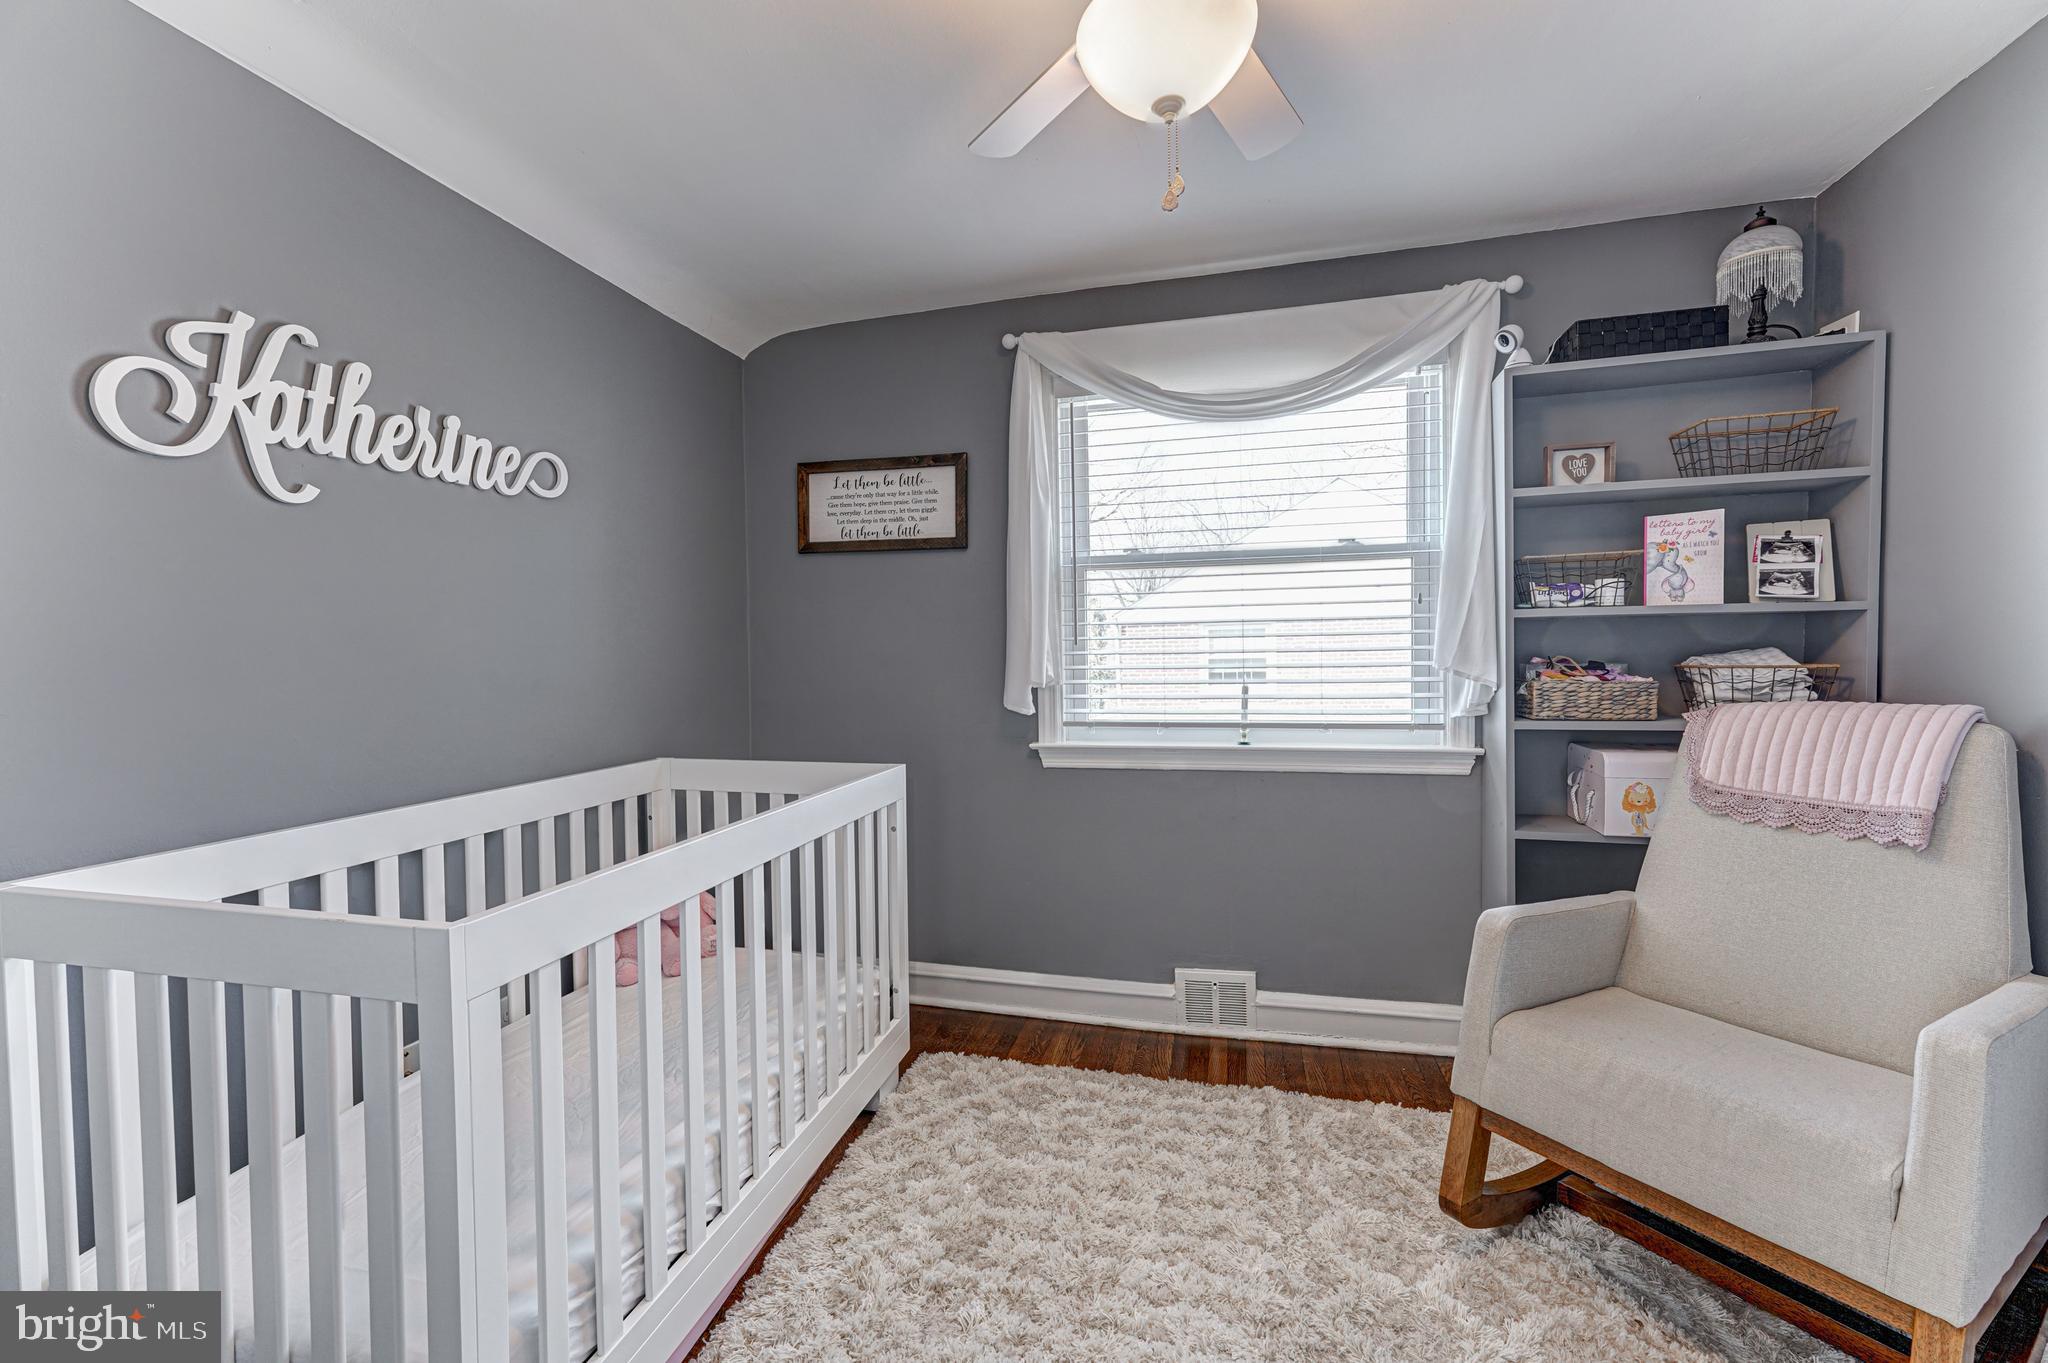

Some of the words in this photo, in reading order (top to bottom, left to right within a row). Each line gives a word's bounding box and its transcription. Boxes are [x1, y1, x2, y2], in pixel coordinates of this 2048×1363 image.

[89, 310, 569, 504] Katherine
[1568, 458, 1588, 469] LOVE
[1572, 467, 1587, 477] YOU
[833, 476, 850, 490] Let
[854, 475, 880, 489] them
[883, 473, 896, 487] be
[1649, 520, 1684, 528] letters
[1687, 517, 1697, 526] to
[1700, 519, 1715, 529] my
[840, 526, 854, 540] let
[856, 525, 880, 539] them
[882, 524, 894, 537] be
[1660, 527, 1683, 540] baby
[1682, 525, 1708, 540] girl
